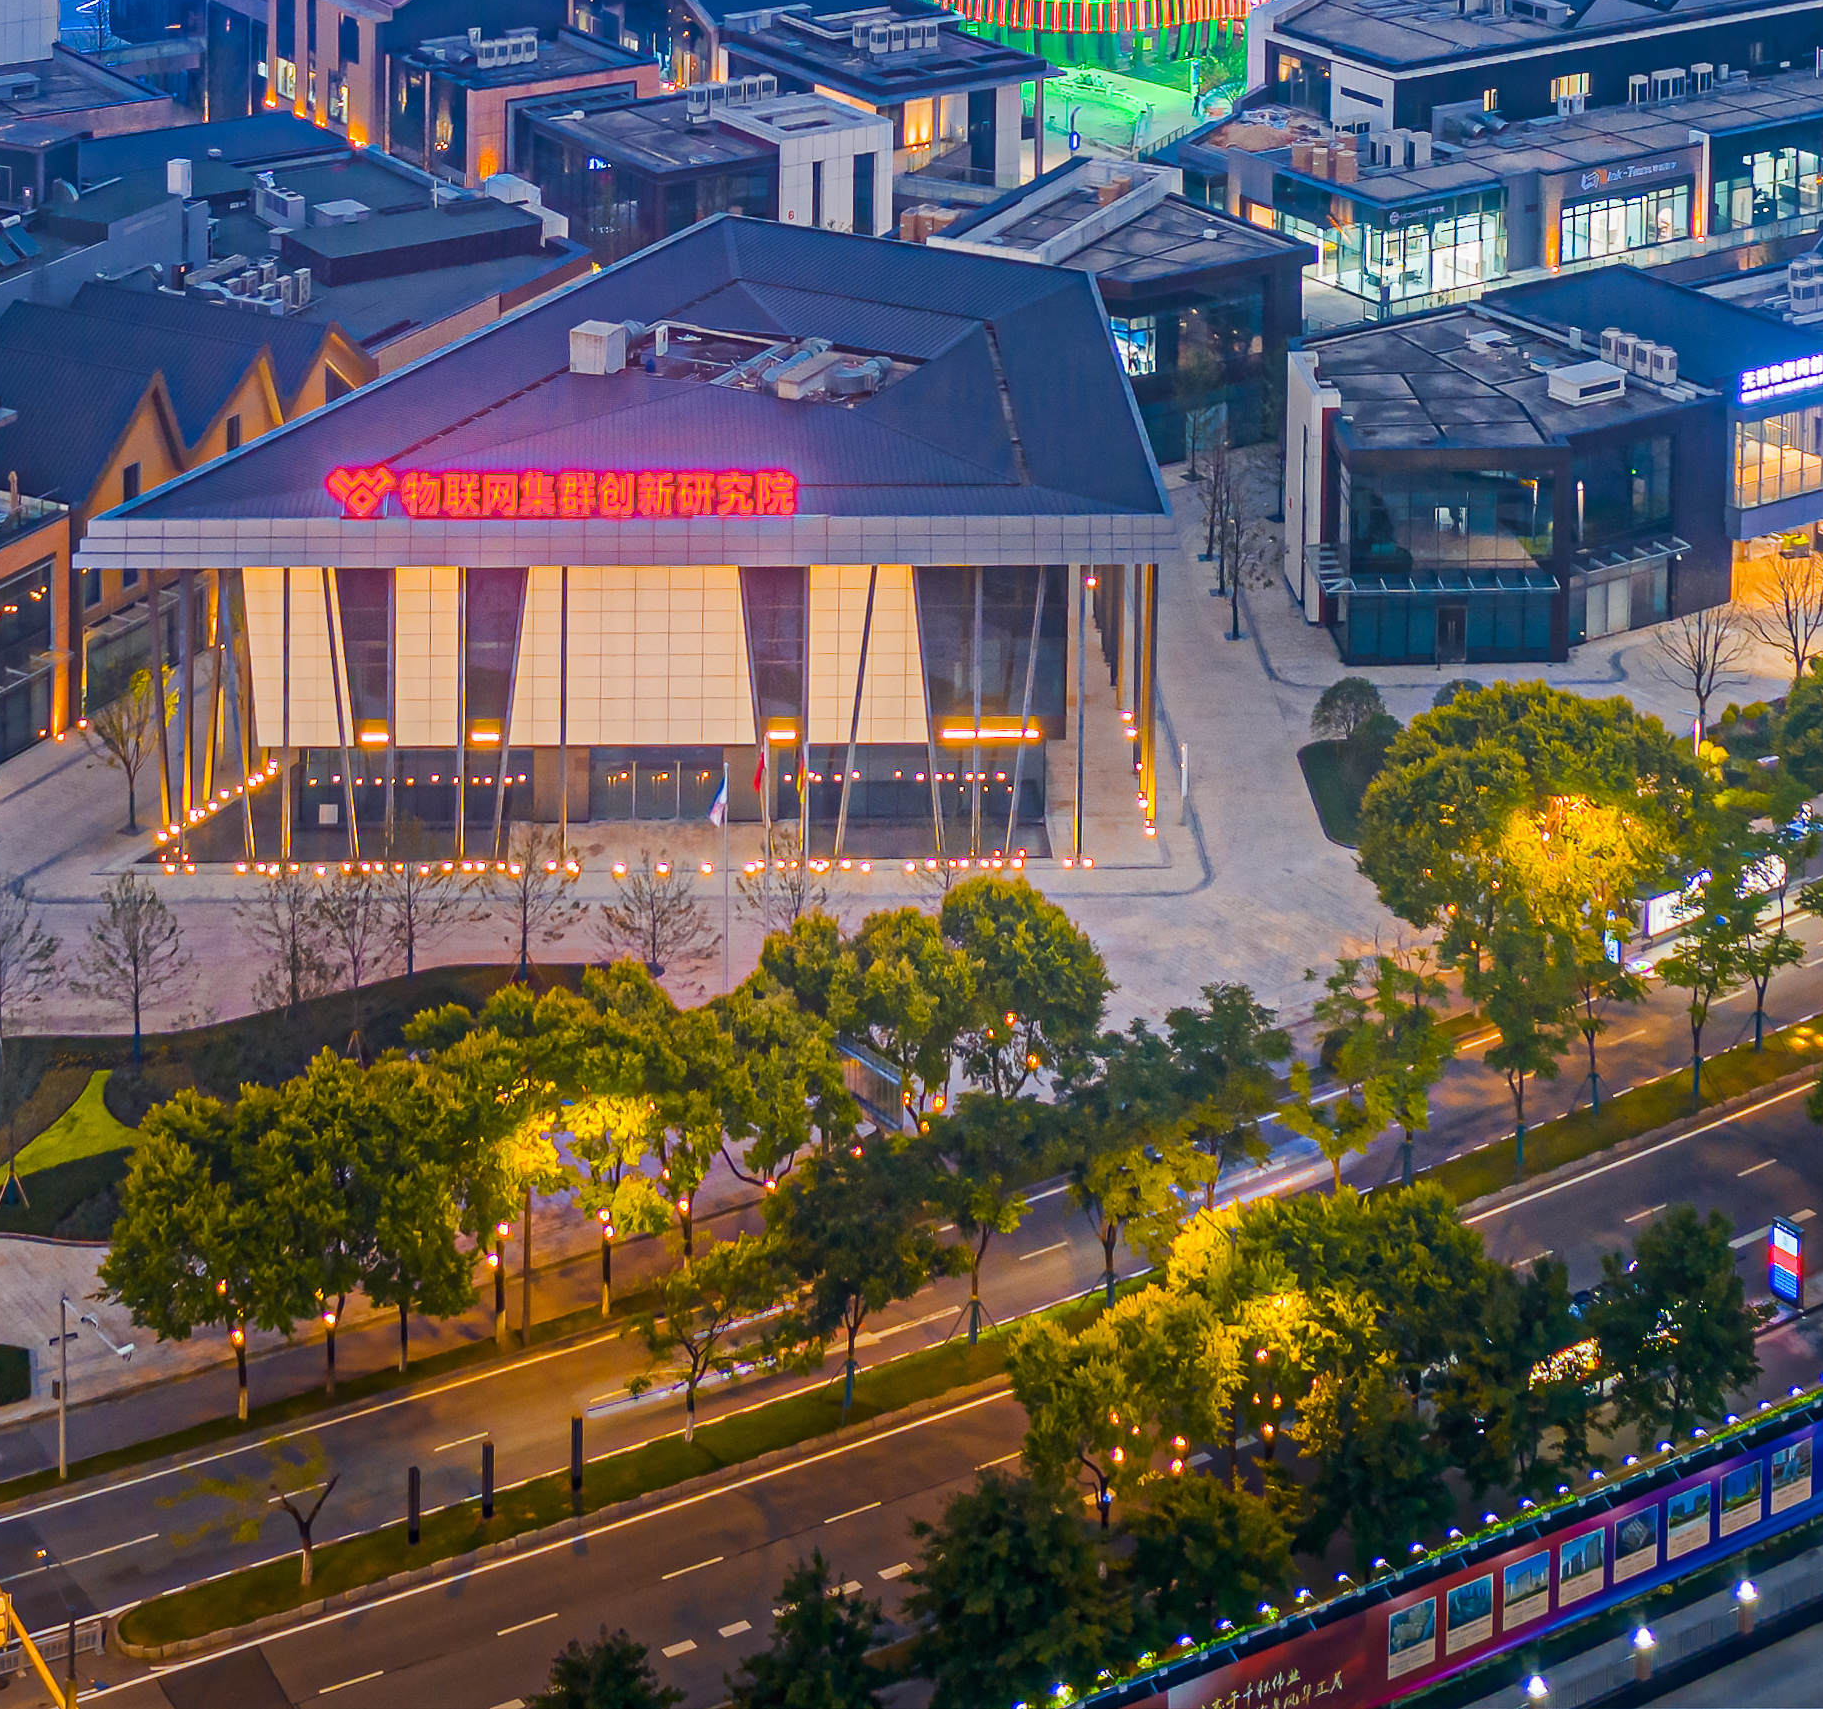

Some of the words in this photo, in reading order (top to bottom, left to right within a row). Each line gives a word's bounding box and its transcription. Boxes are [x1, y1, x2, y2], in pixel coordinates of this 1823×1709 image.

[401, 470, 798, 517] 物联网集群创新研究院
